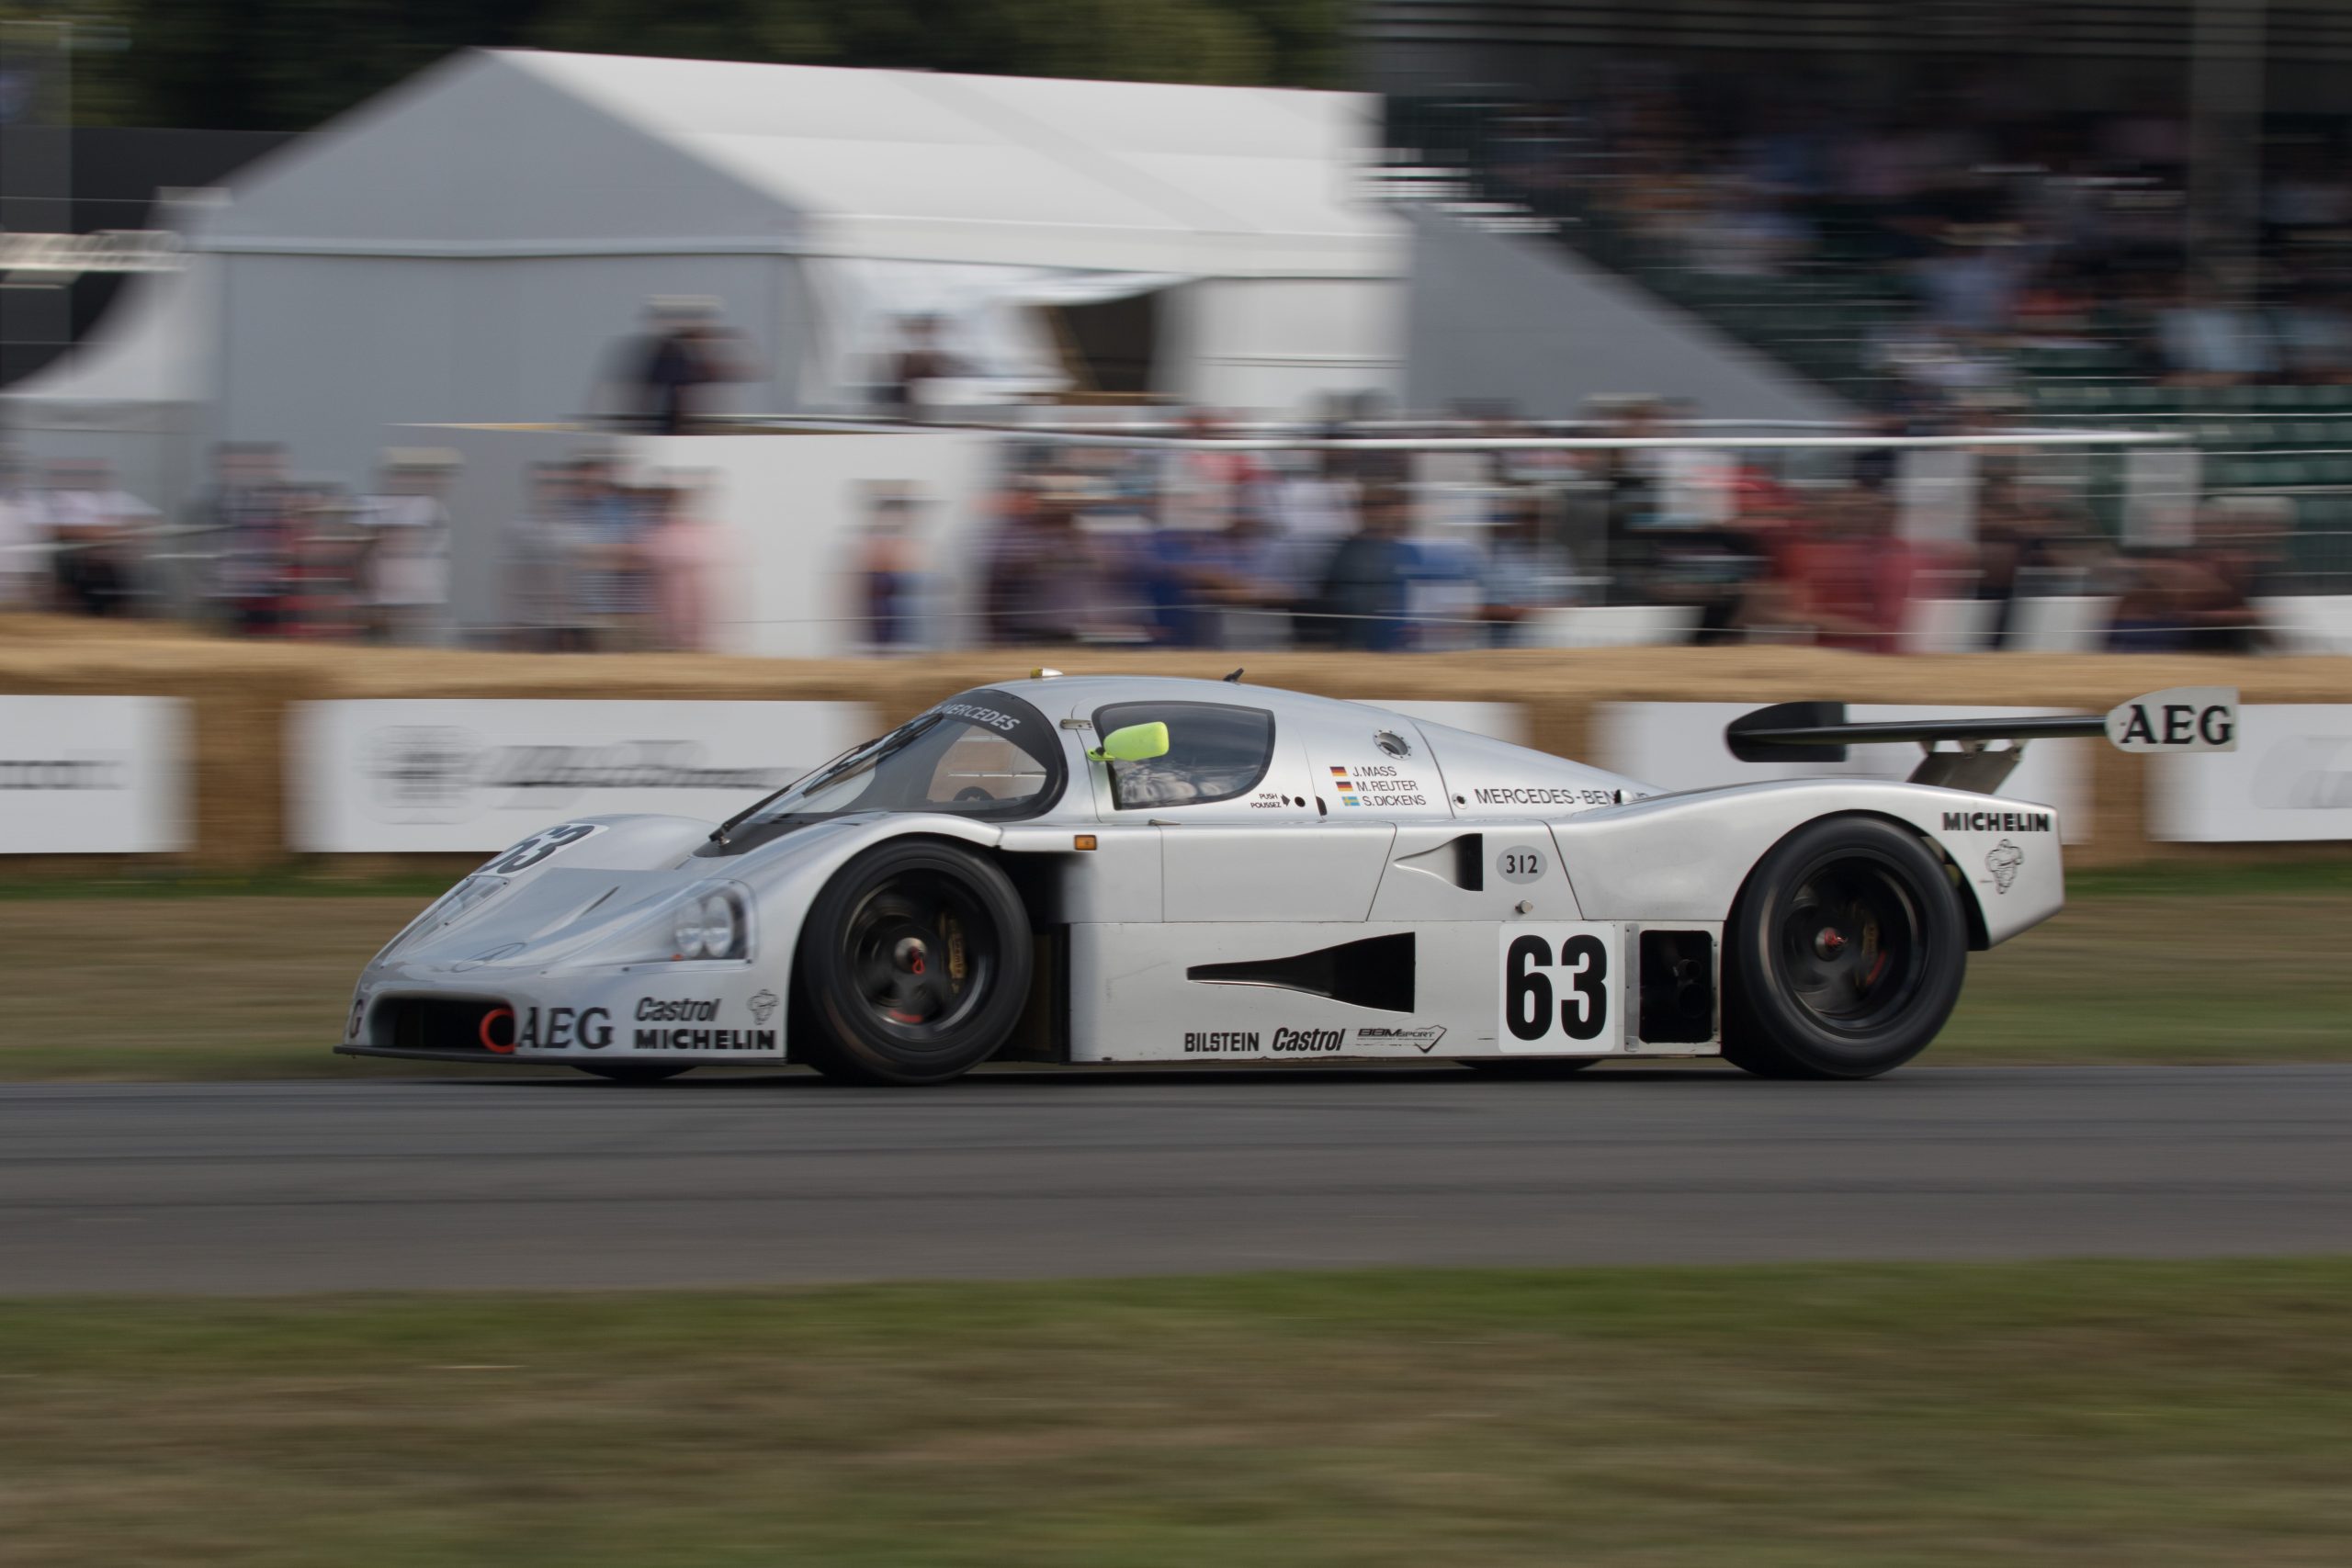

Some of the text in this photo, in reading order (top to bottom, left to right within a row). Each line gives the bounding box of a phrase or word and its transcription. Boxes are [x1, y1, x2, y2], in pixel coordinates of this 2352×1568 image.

[942, 704, 1021, 730] MERCEDES
[2120, 705, 2234, 745] AEG
[1357, 781, 1419, 792] M.REUTER
[1474, 789, 1616, 805] MERCEDES-BEN
[1363, 795, 1426, 807] S.DICKENS
[1942, 812, 2051, 831] MICHELIN
[1506, 854, 1538, 874] 312
[1506, 934, 1608, 1041] 63
[636, 997, 720, 1022] Castrol
[516, 1007, 615, 1050] AEG
[634, 1030, 775, 1050] MICHELIN
[1184, 1032, 1260, 1053] BILSTEIN
[1272, 1027, 1346, 1052] Castrol
